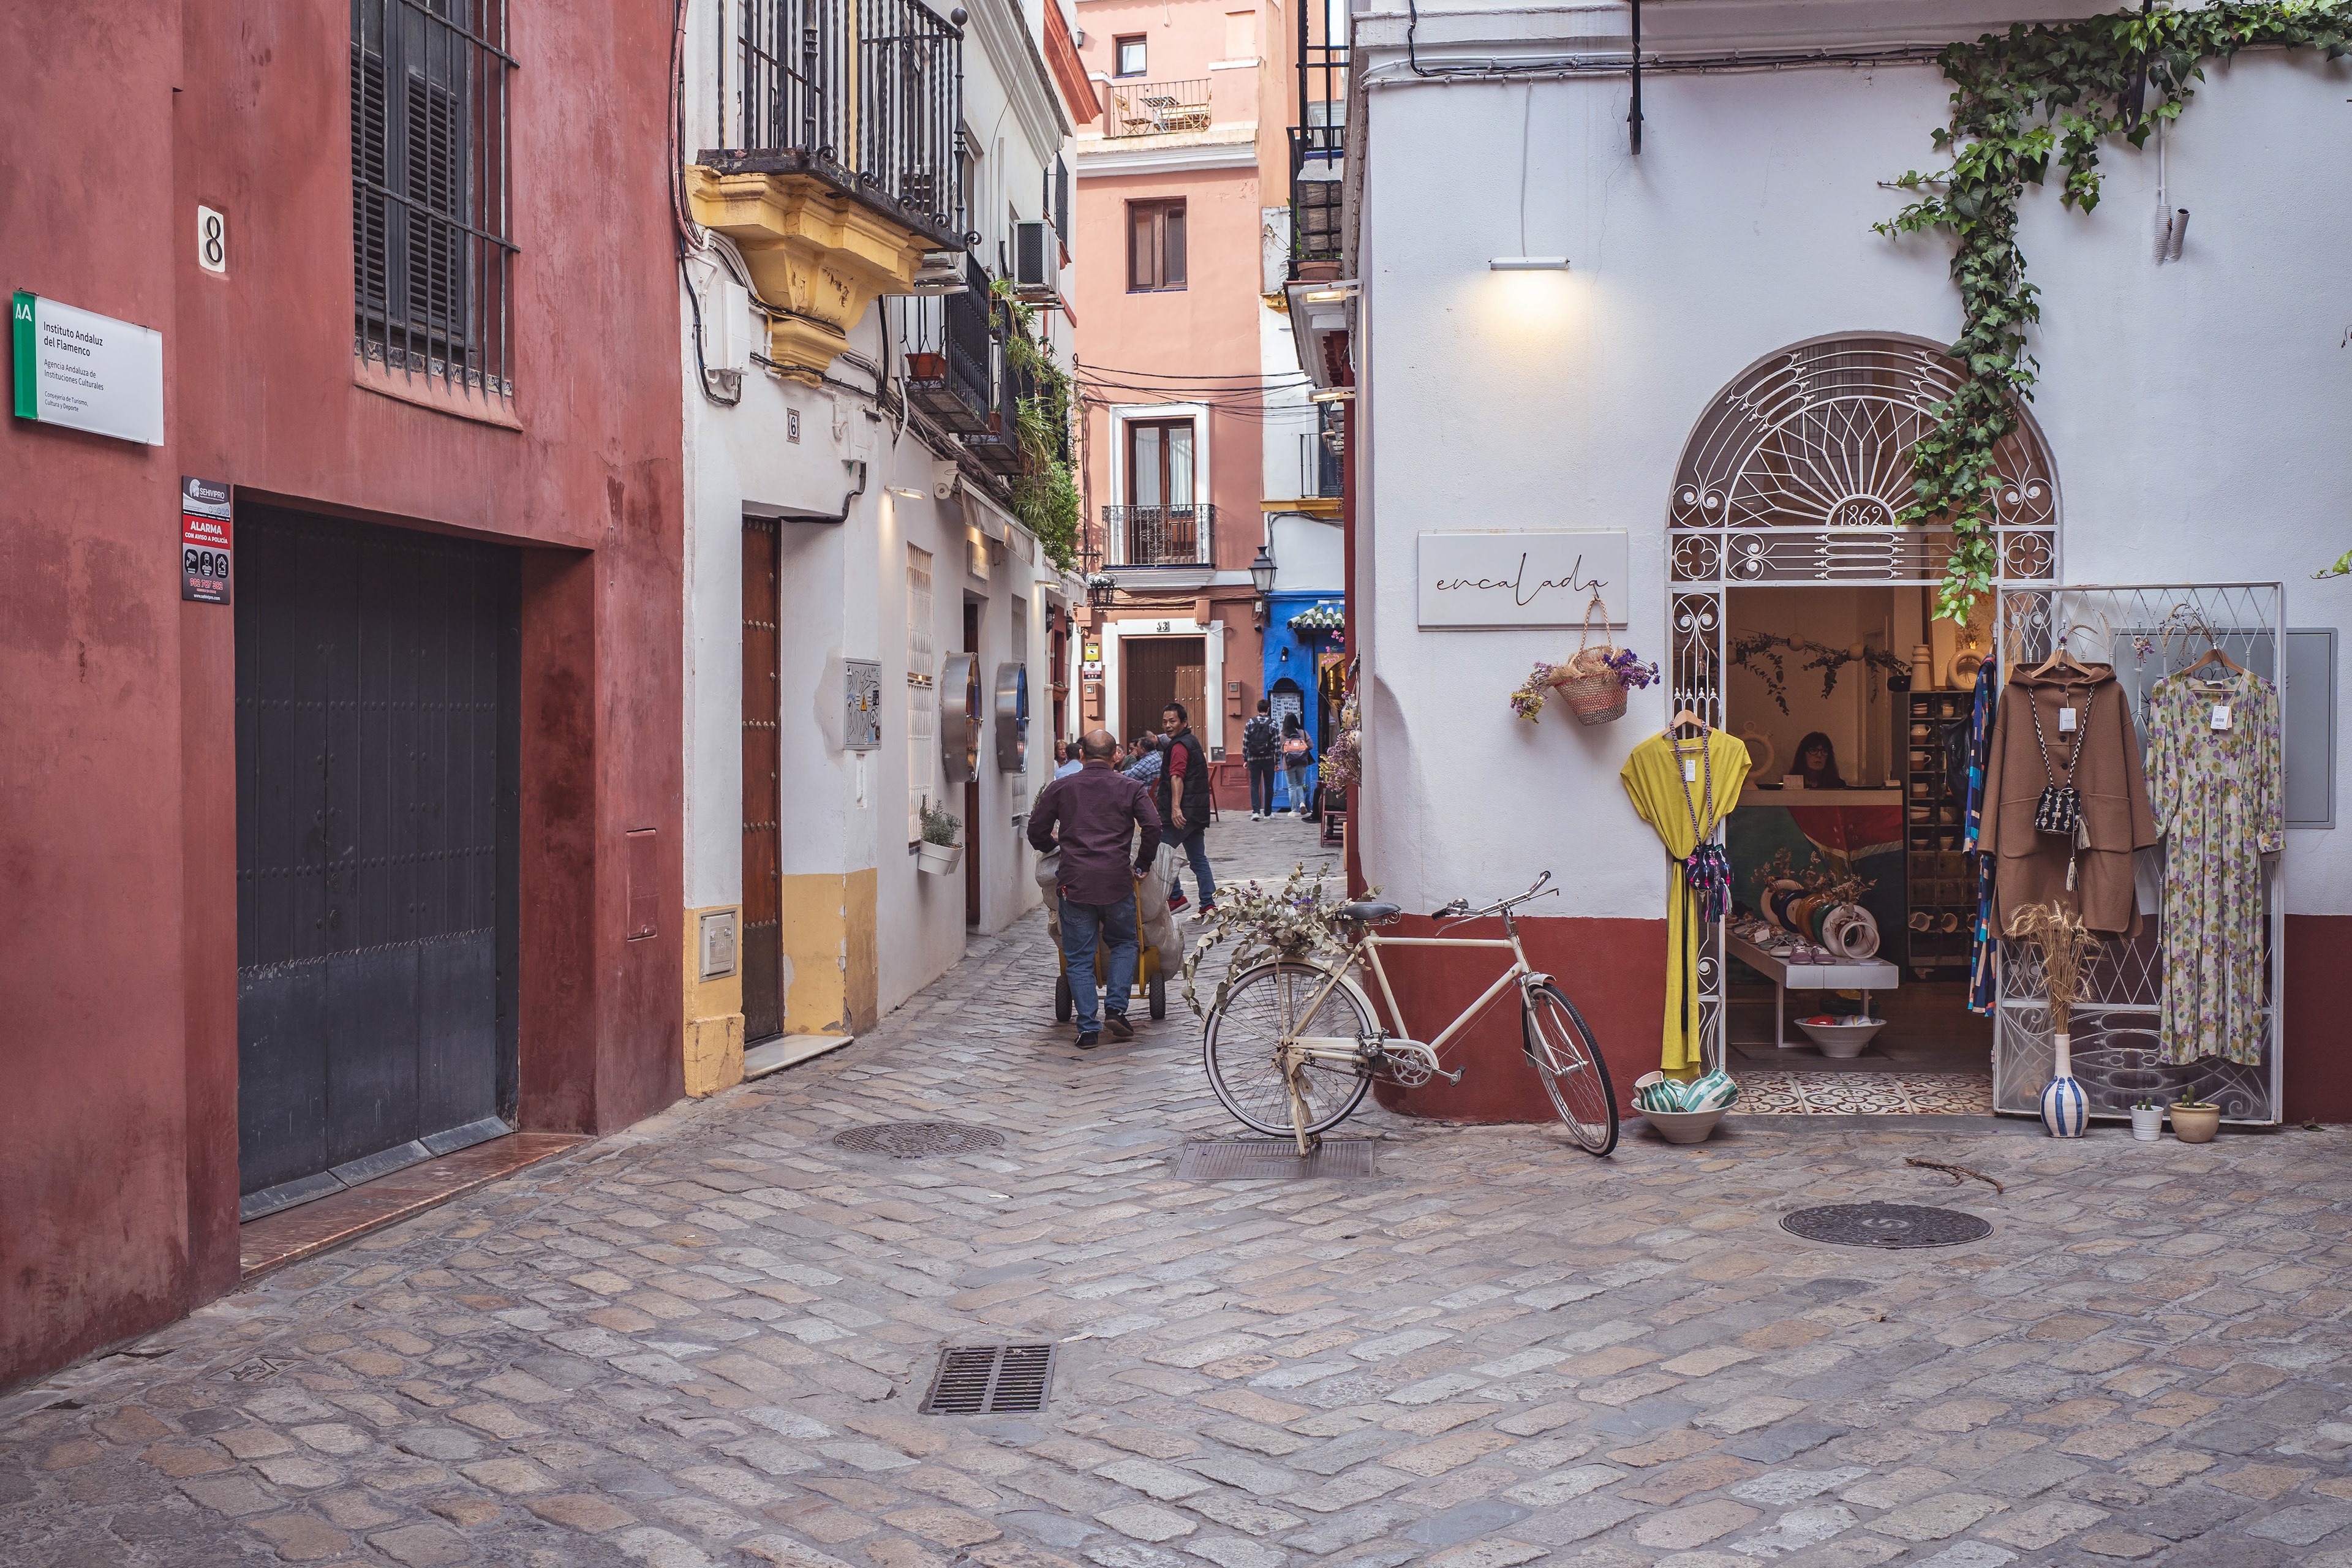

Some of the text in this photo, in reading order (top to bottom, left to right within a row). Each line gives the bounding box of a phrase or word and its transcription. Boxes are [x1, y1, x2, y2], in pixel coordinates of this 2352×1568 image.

[206, 216, 222, 262] 8
[43, 321, 103, 346] Instituto Andaluz
[43, 336, 91, 356] del Flamenco
[44, 359, 96, 379] Agencia Andaluza de
[44, 370, 104, 391] Instituciones Culturales
[45, 399, 59, 408] Cultura
[63, 402, 79, 412] Deporte
[71, 397, 89, 407] Turismo,
[791, 417, 796, 435] 6
[200, 488, 225, 499] SEHIVIPRO
[1838, 505, 1883, 526] 1862
[190, 521, 222, 535] ALARMA
[190, 578, 200, 587] 902
[201, 579, 212, 588] 767
[1436, 552, 1608, 606] encalada
